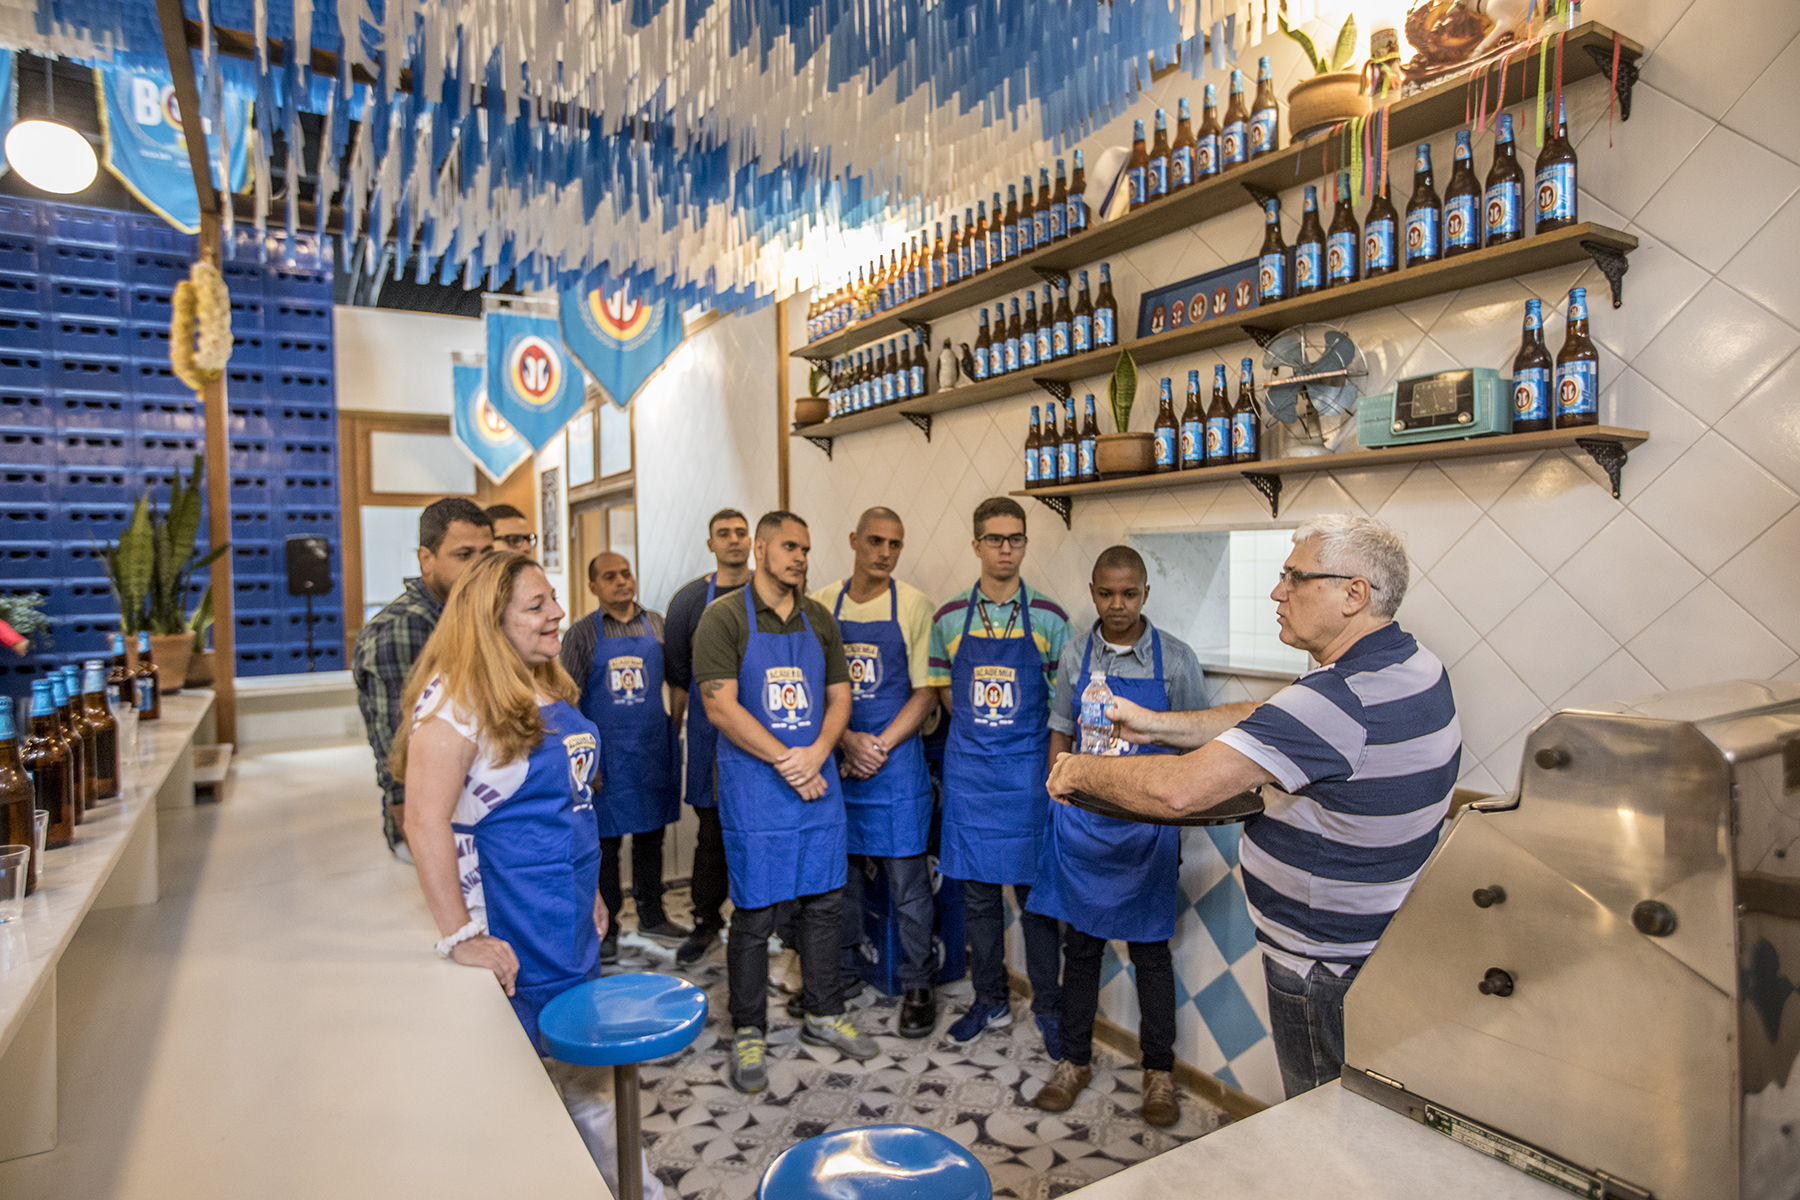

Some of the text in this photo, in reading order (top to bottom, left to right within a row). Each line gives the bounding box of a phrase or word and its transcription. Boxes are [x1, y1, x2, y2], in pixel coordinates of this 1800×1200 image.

[611, 669, 645, 691] BOA
[768, 683, 809, 711] BOA
[974, 681, 1014, 708] BOA
